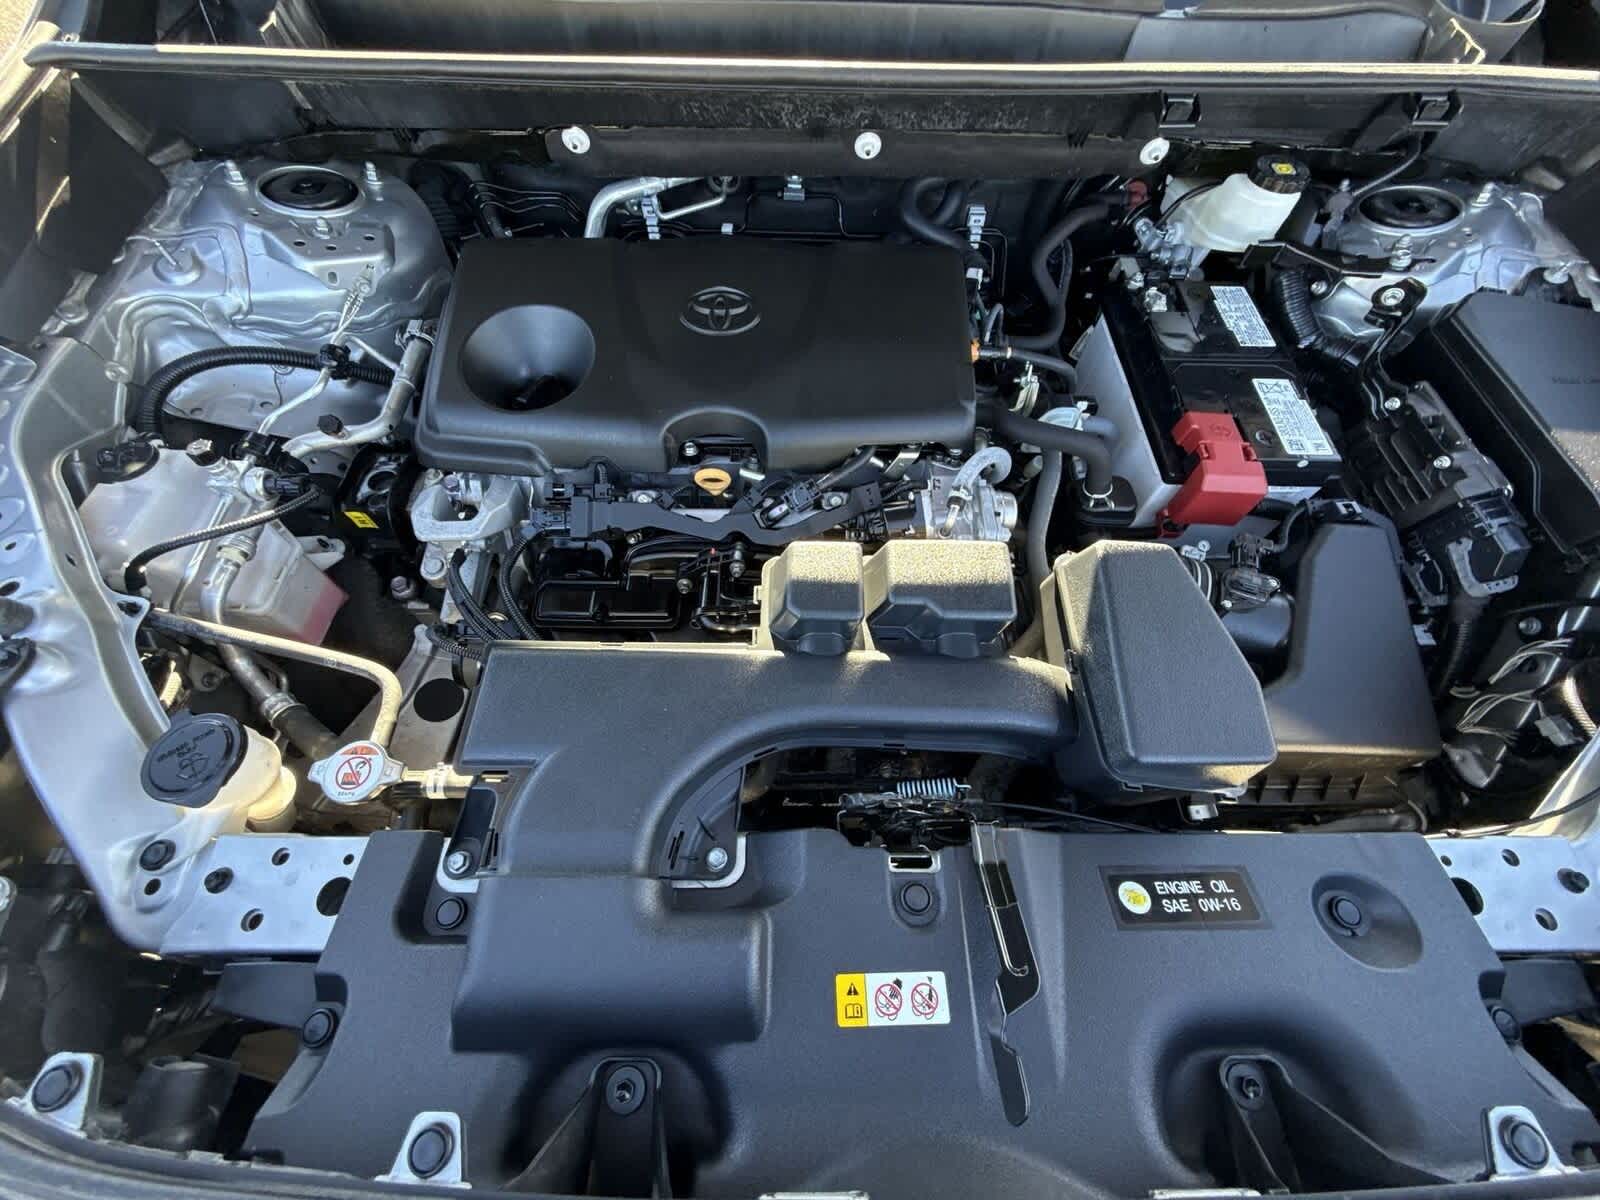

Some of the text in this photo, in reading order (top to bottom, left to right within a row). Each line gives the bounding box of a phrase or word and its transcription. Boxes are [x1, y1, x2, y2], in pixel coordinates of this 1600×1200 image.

[1154, 880, 1235, 895] ENGINE OIL
[1162, 897, 1242, 913] SAE 0W-16
